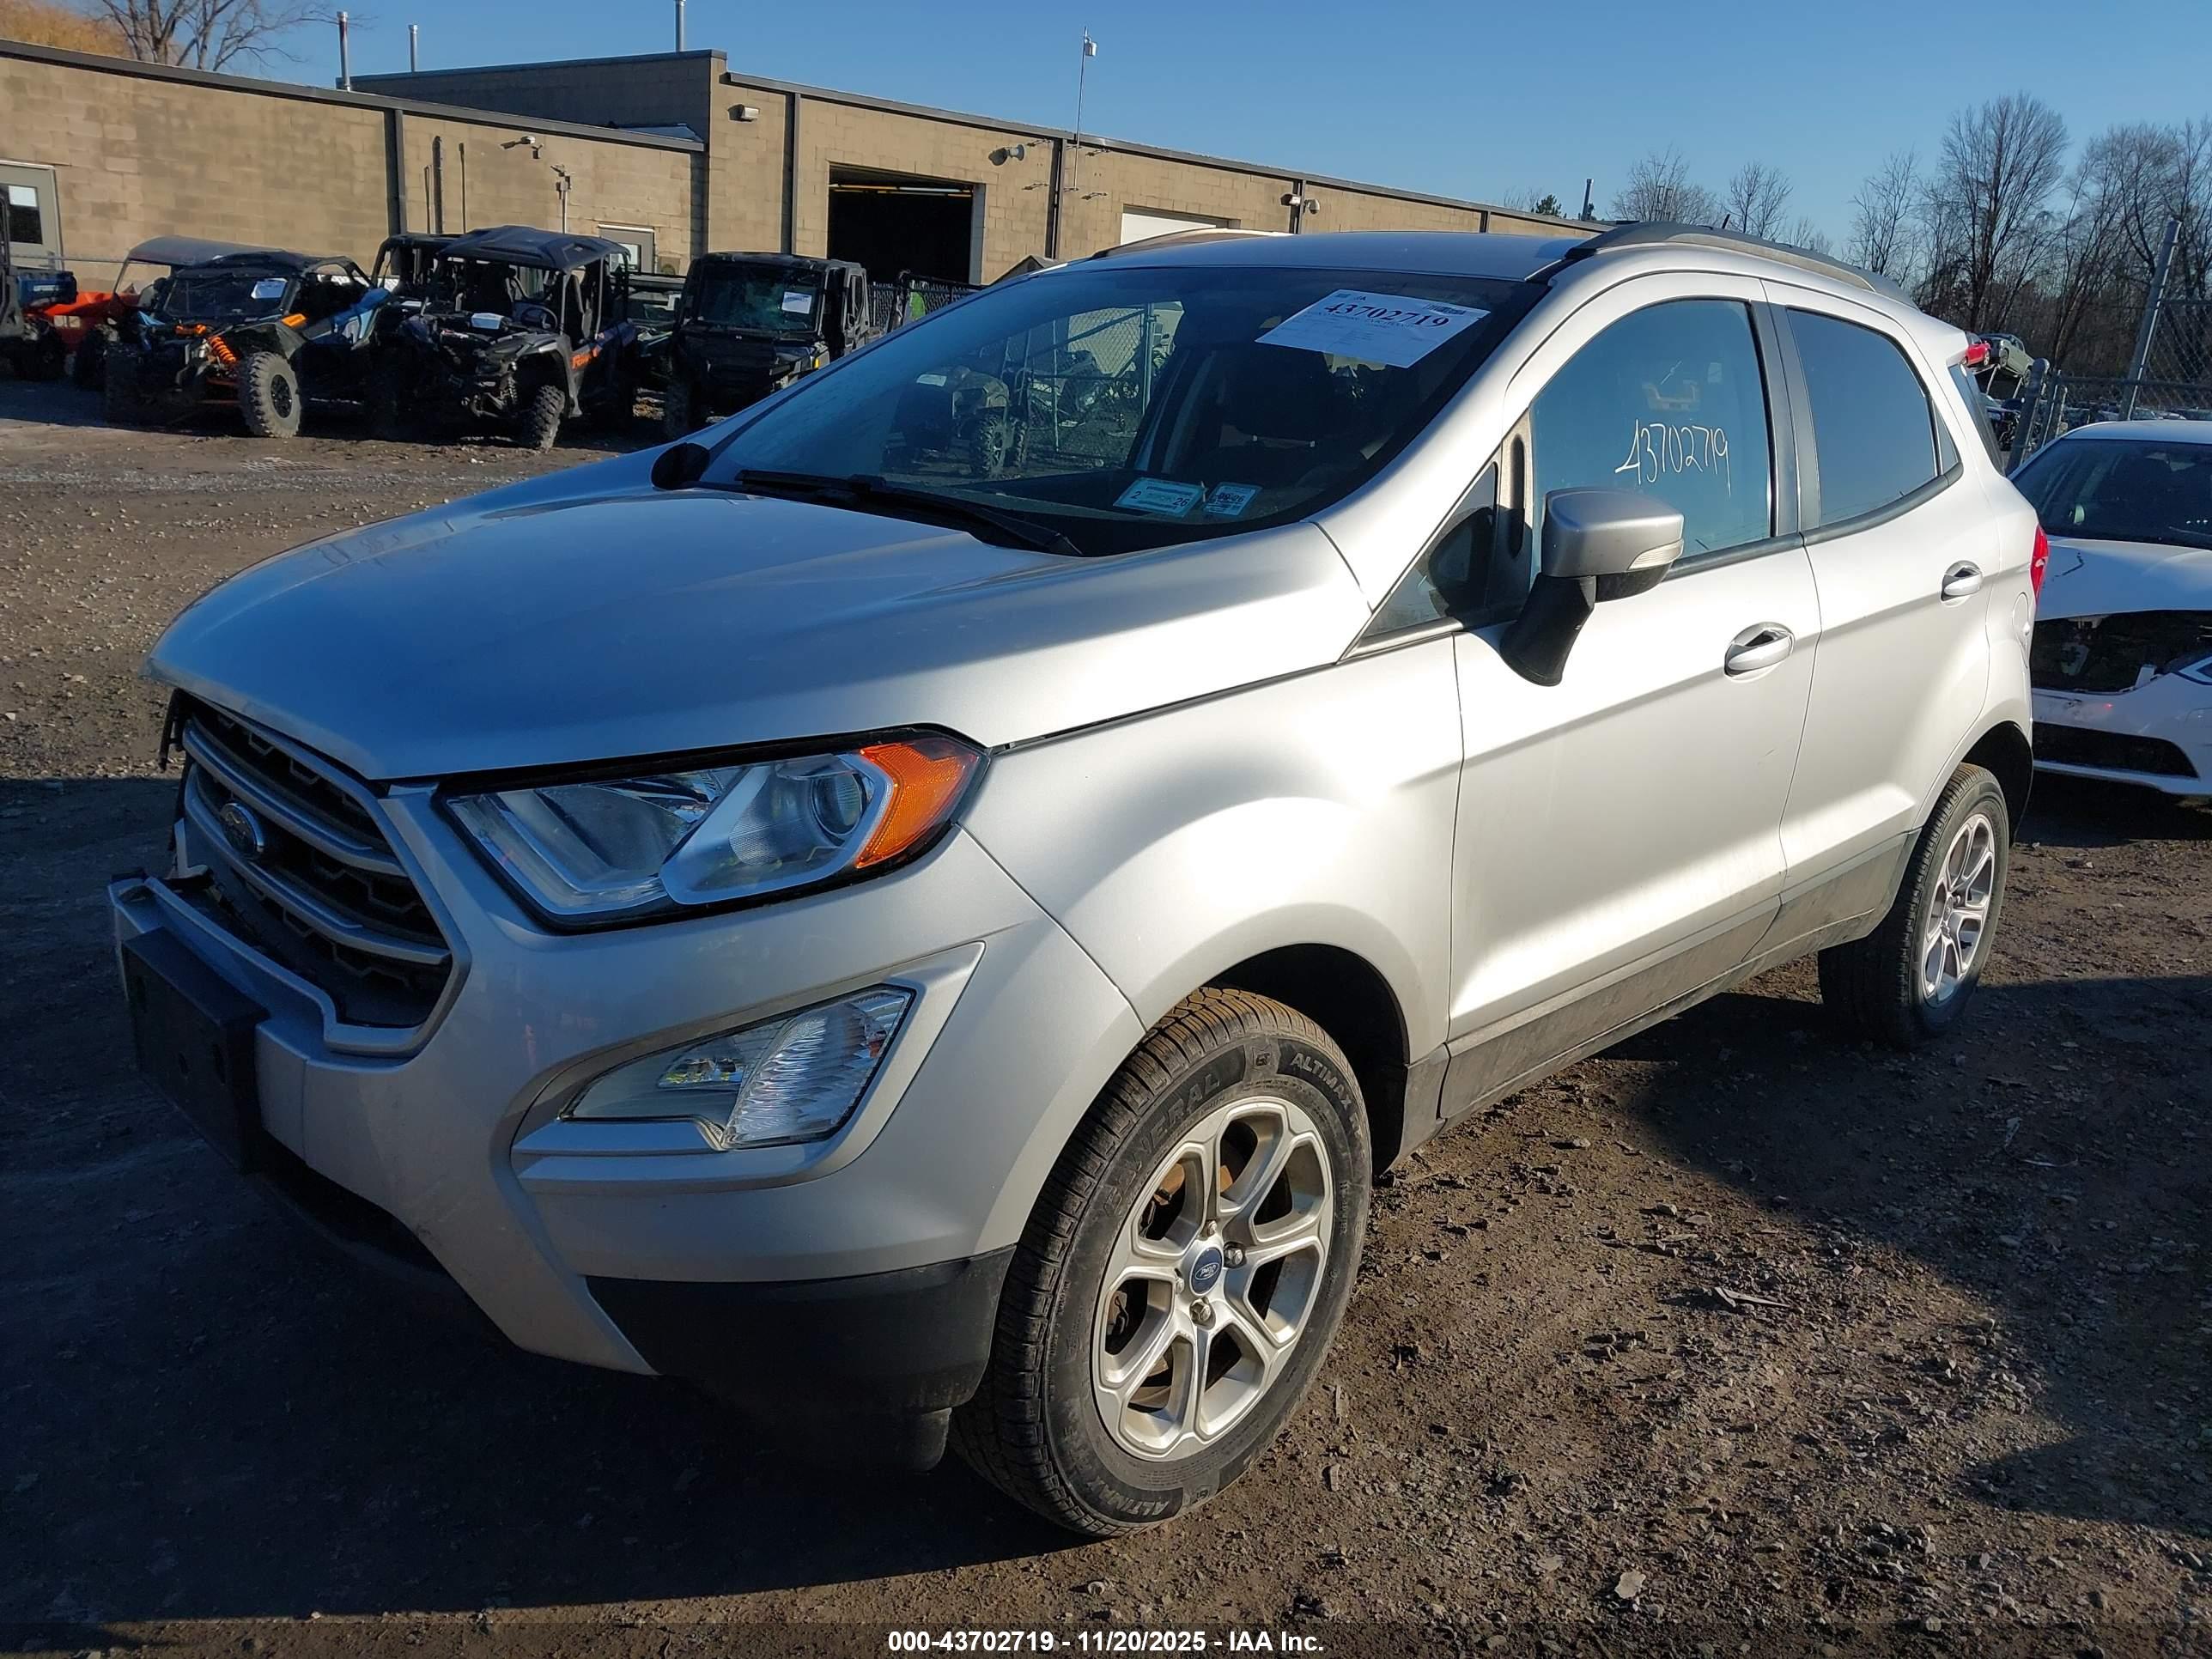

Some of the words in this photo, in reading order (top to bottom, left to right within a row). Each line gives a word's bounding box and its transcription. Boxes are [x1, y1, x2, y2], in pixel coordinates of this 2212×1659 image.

[1323, 302, 1450, 327] 43702719
[1614, 418, 1731, 497] 43702719
[1130, 490, 1142, 499] 2
[1290, 1052, 1352, 1111] ALTIMAX
